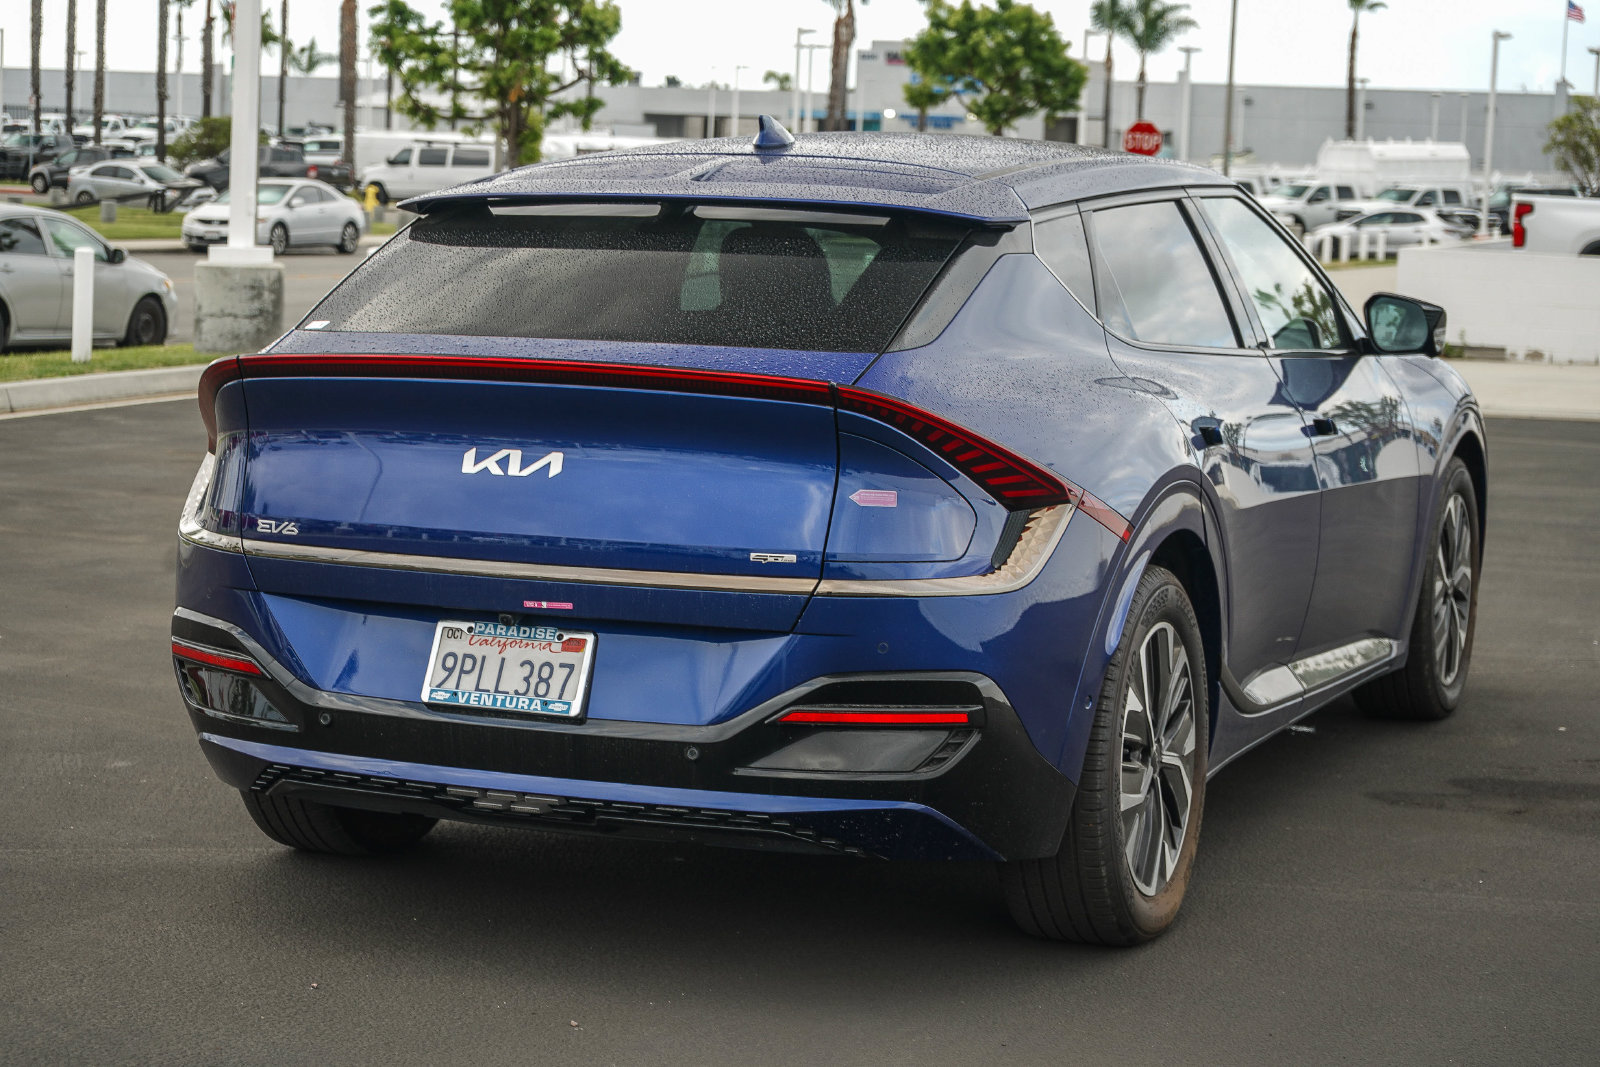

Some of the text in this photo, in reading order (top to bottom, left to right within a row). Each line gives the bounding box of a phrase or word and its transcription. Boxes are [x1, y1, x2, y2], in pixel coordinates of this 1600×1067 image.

[1127, 131, 1162, 150] STOP
[461, 447, 564, 478] KIA
[256, 519, 299, 536] EV6
[446, 628, 463, 640] OCT
[474, 621, 556, 641] PARADISE
[468, 634, 562, 654] California
[435, 651, 576, 700] 9PLL387
[457, 691, 542, 711] VENTURA
